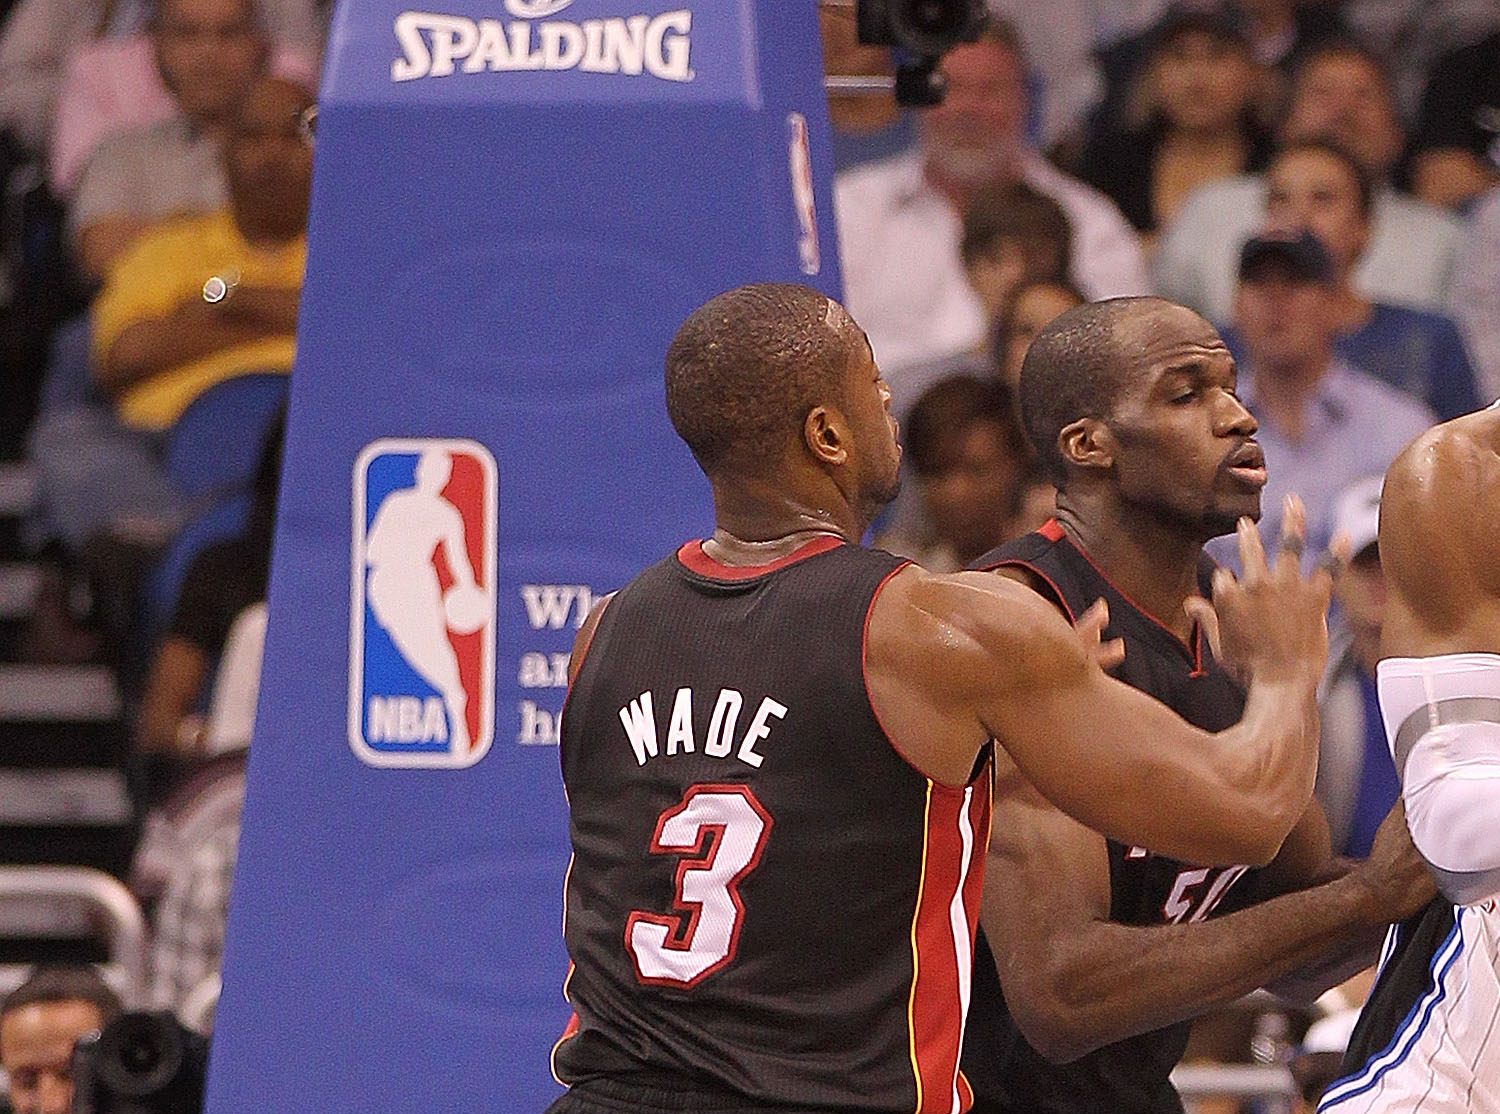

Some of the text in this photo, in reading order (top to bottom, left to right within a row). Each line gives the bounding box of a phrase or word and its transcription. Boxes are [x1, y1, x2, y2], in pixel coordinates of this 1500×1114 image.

[391, 10, 693, 82] SPALDING
[367, 694, 450, 745] NBA
[617, 686, 790, 769] WADE
[624, 782, 775, 991] 3
